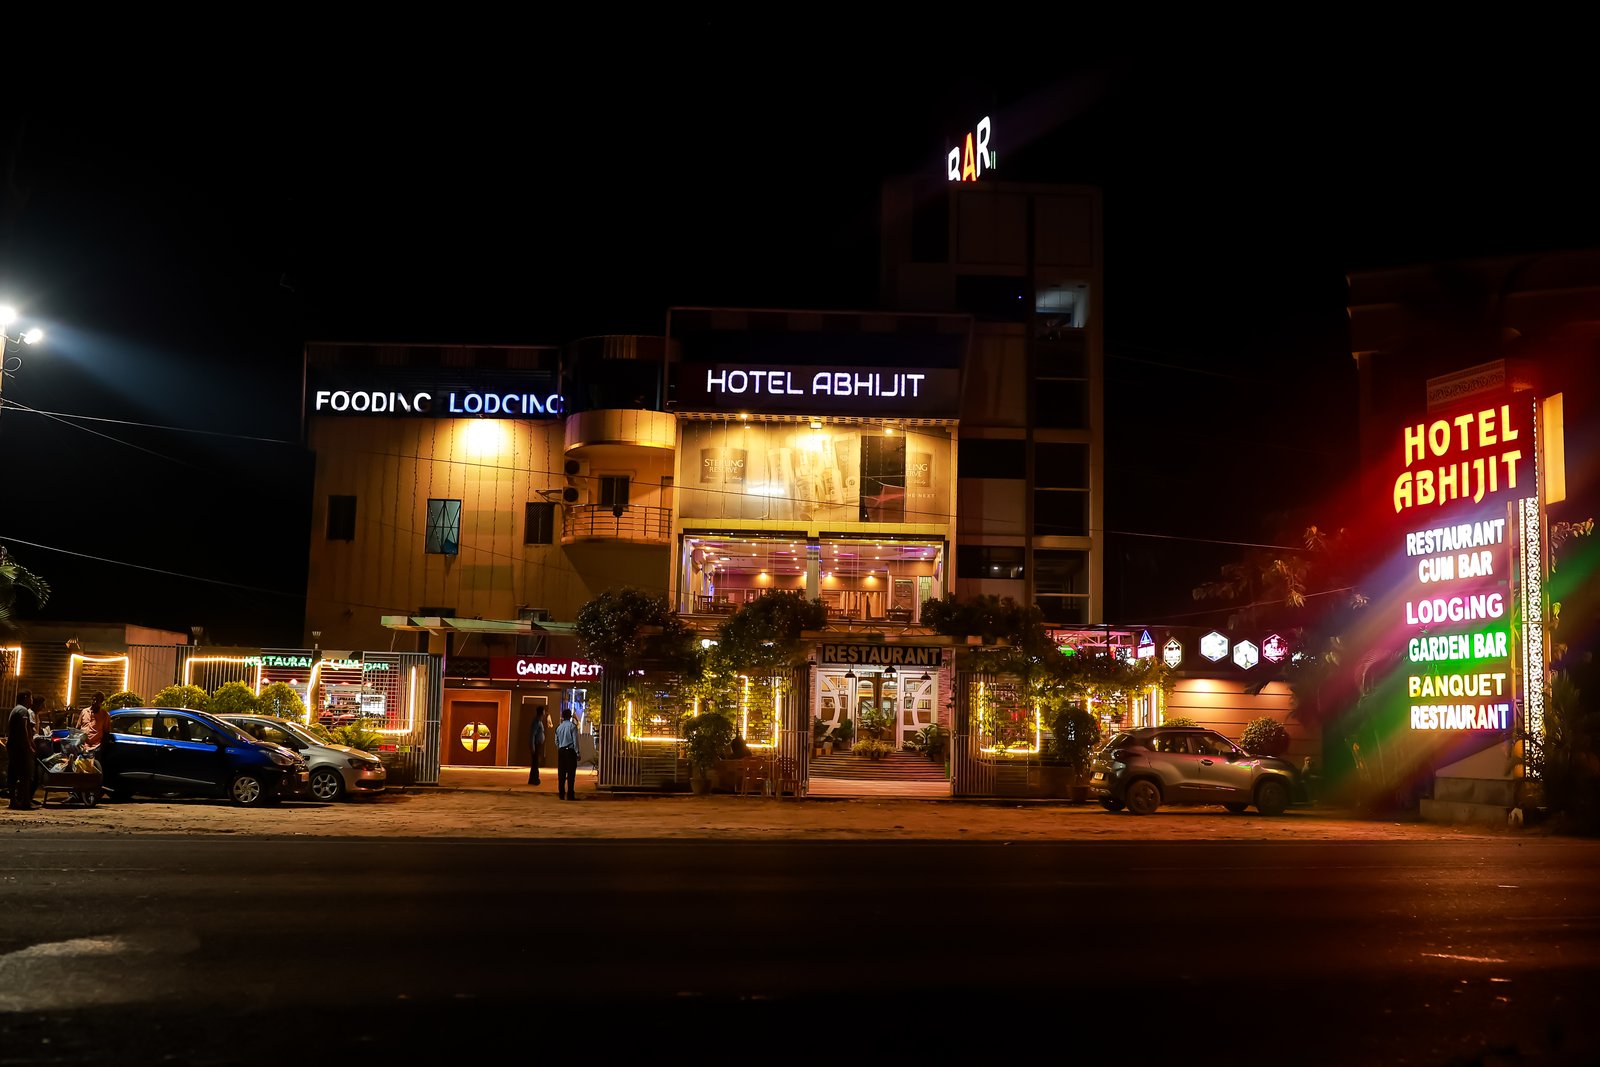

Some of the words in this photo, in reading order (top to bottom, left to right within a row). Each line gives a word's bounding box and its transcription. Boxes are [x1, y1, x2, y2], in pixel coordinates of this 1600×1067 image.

[706, 369, 804, 395] HOTEL
[811, 372, 925, 397] ABHIJIT
[1404, 404, 1519, 468] HOTEL
[1393, 449, 1522, 514] ABHIJIT
[1406, 518, 1505, 556] RESTAURANT
[1418, 555, 1455, 584] CUM
[1457, 550, 1494, 579] BAR
[1406, 592, 1504, 625] LODGING
[824, 645, 940, 665] RESTAURANT
[1408, 635, 1471, 663] GARDEN
[1473, 631, 1508, 658] BAR
[1408, 672, 1507, 698] BANQUET
[1410, 703, 1510, 730] RESTAURANT
